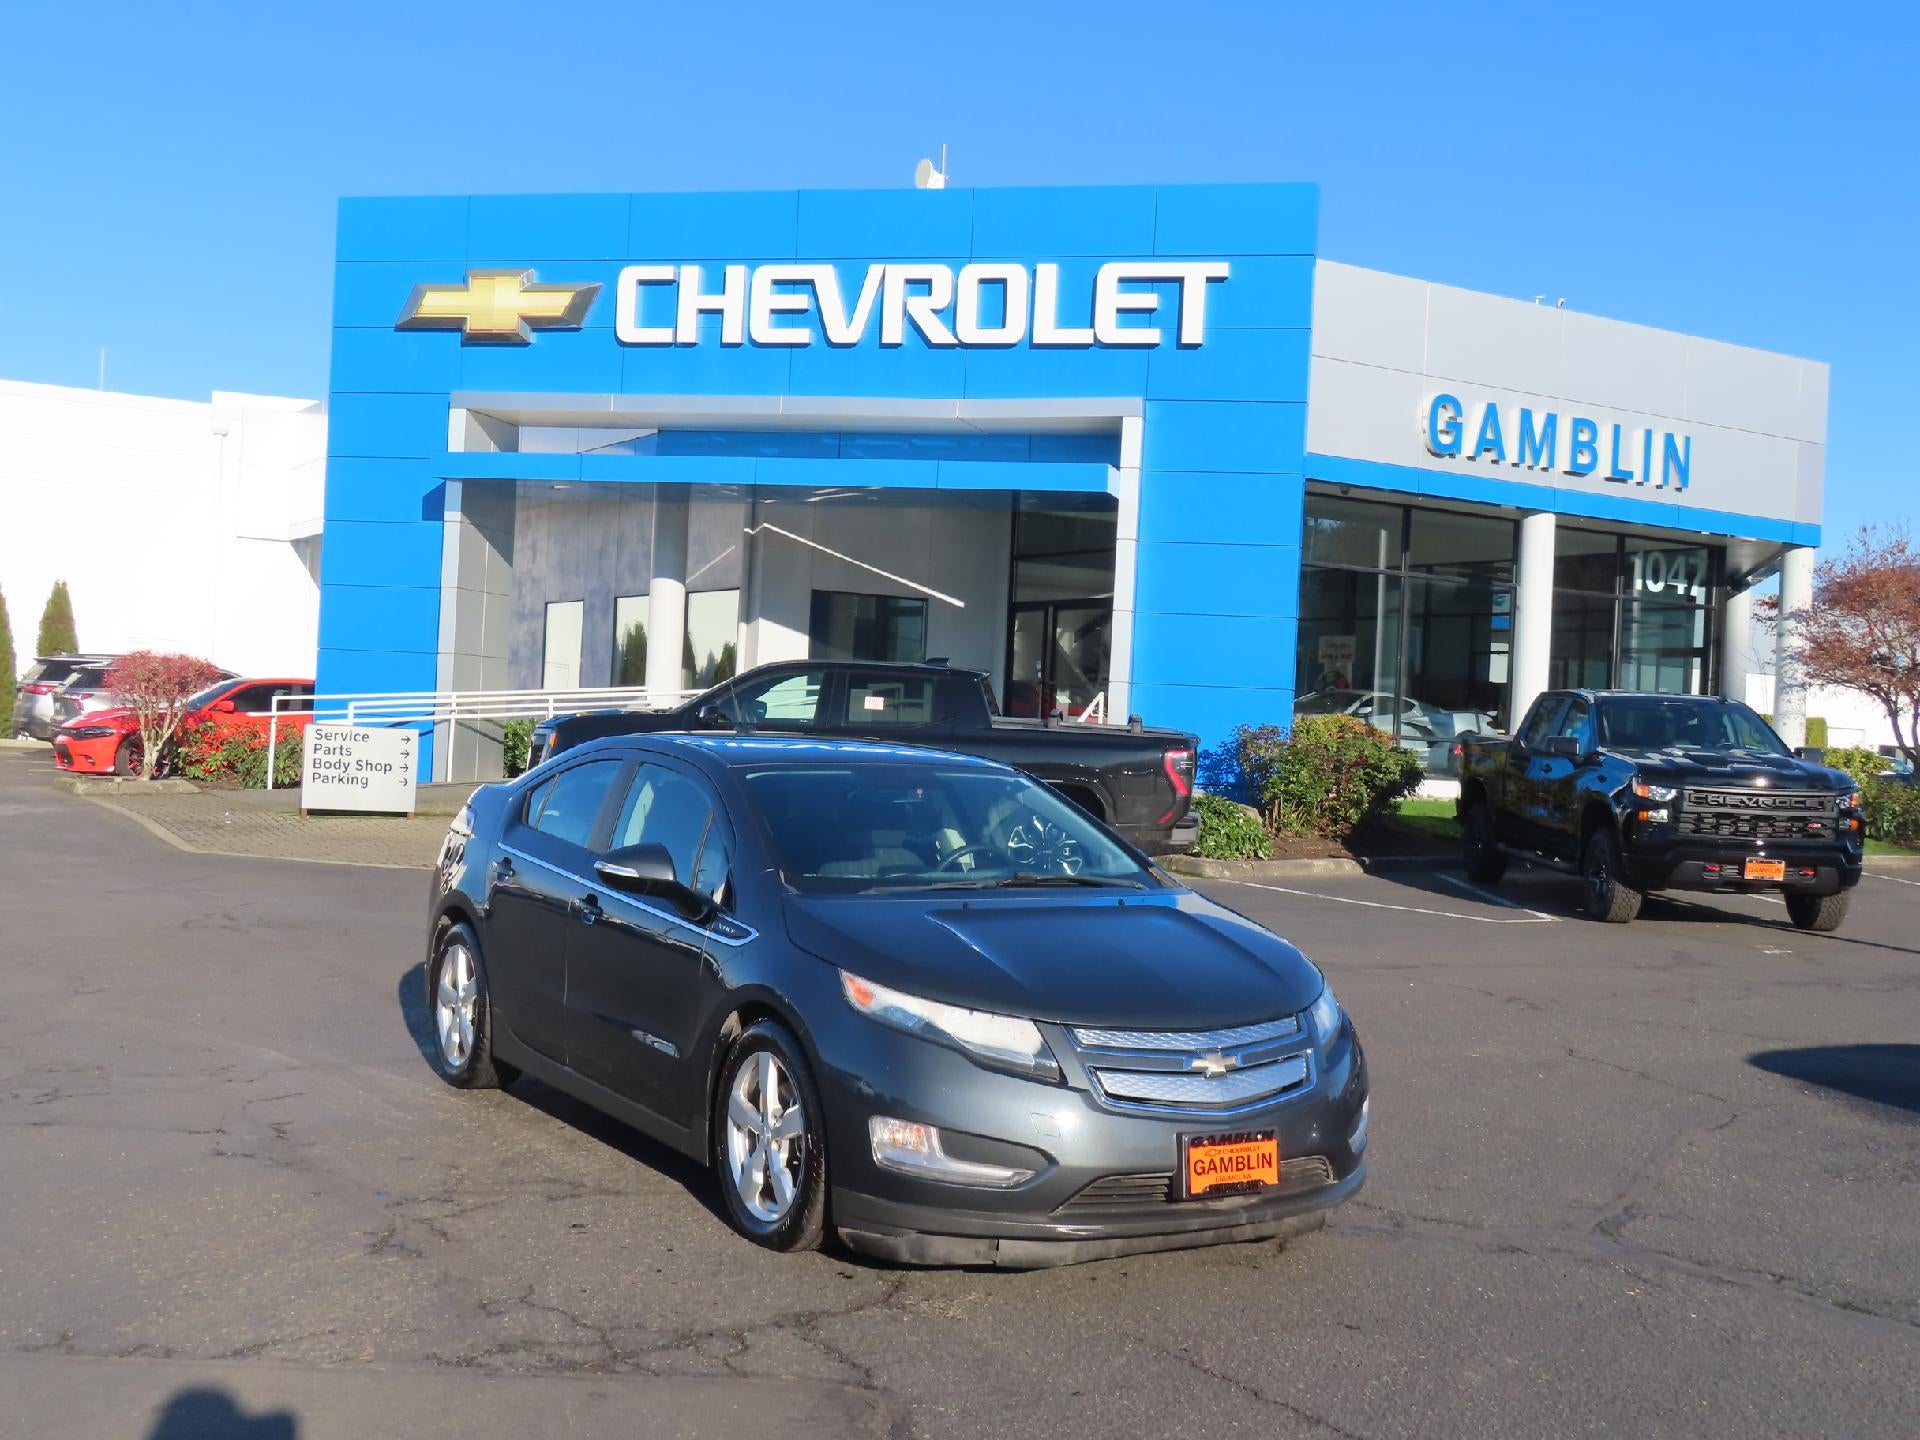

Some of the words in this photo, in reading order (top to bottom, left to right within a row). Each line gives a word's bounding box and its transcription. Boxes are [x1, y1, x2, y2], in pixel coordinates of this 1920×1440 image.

[615, 261, 1229, 348] CHEVROLET
[1427, 393, 1691, 490] GAMBLIN
[1630, 550, 1708, 596] 1047
[314, 728, 370, 743] Service
[313, 743, 352, 757] Parts
[312, 757, 351, 774] Body
[355, 759, 393, 775] Shop
[312, 772, 369, 789] Parking
[1193, 1152, 1273, 1177] GAMBLIN
